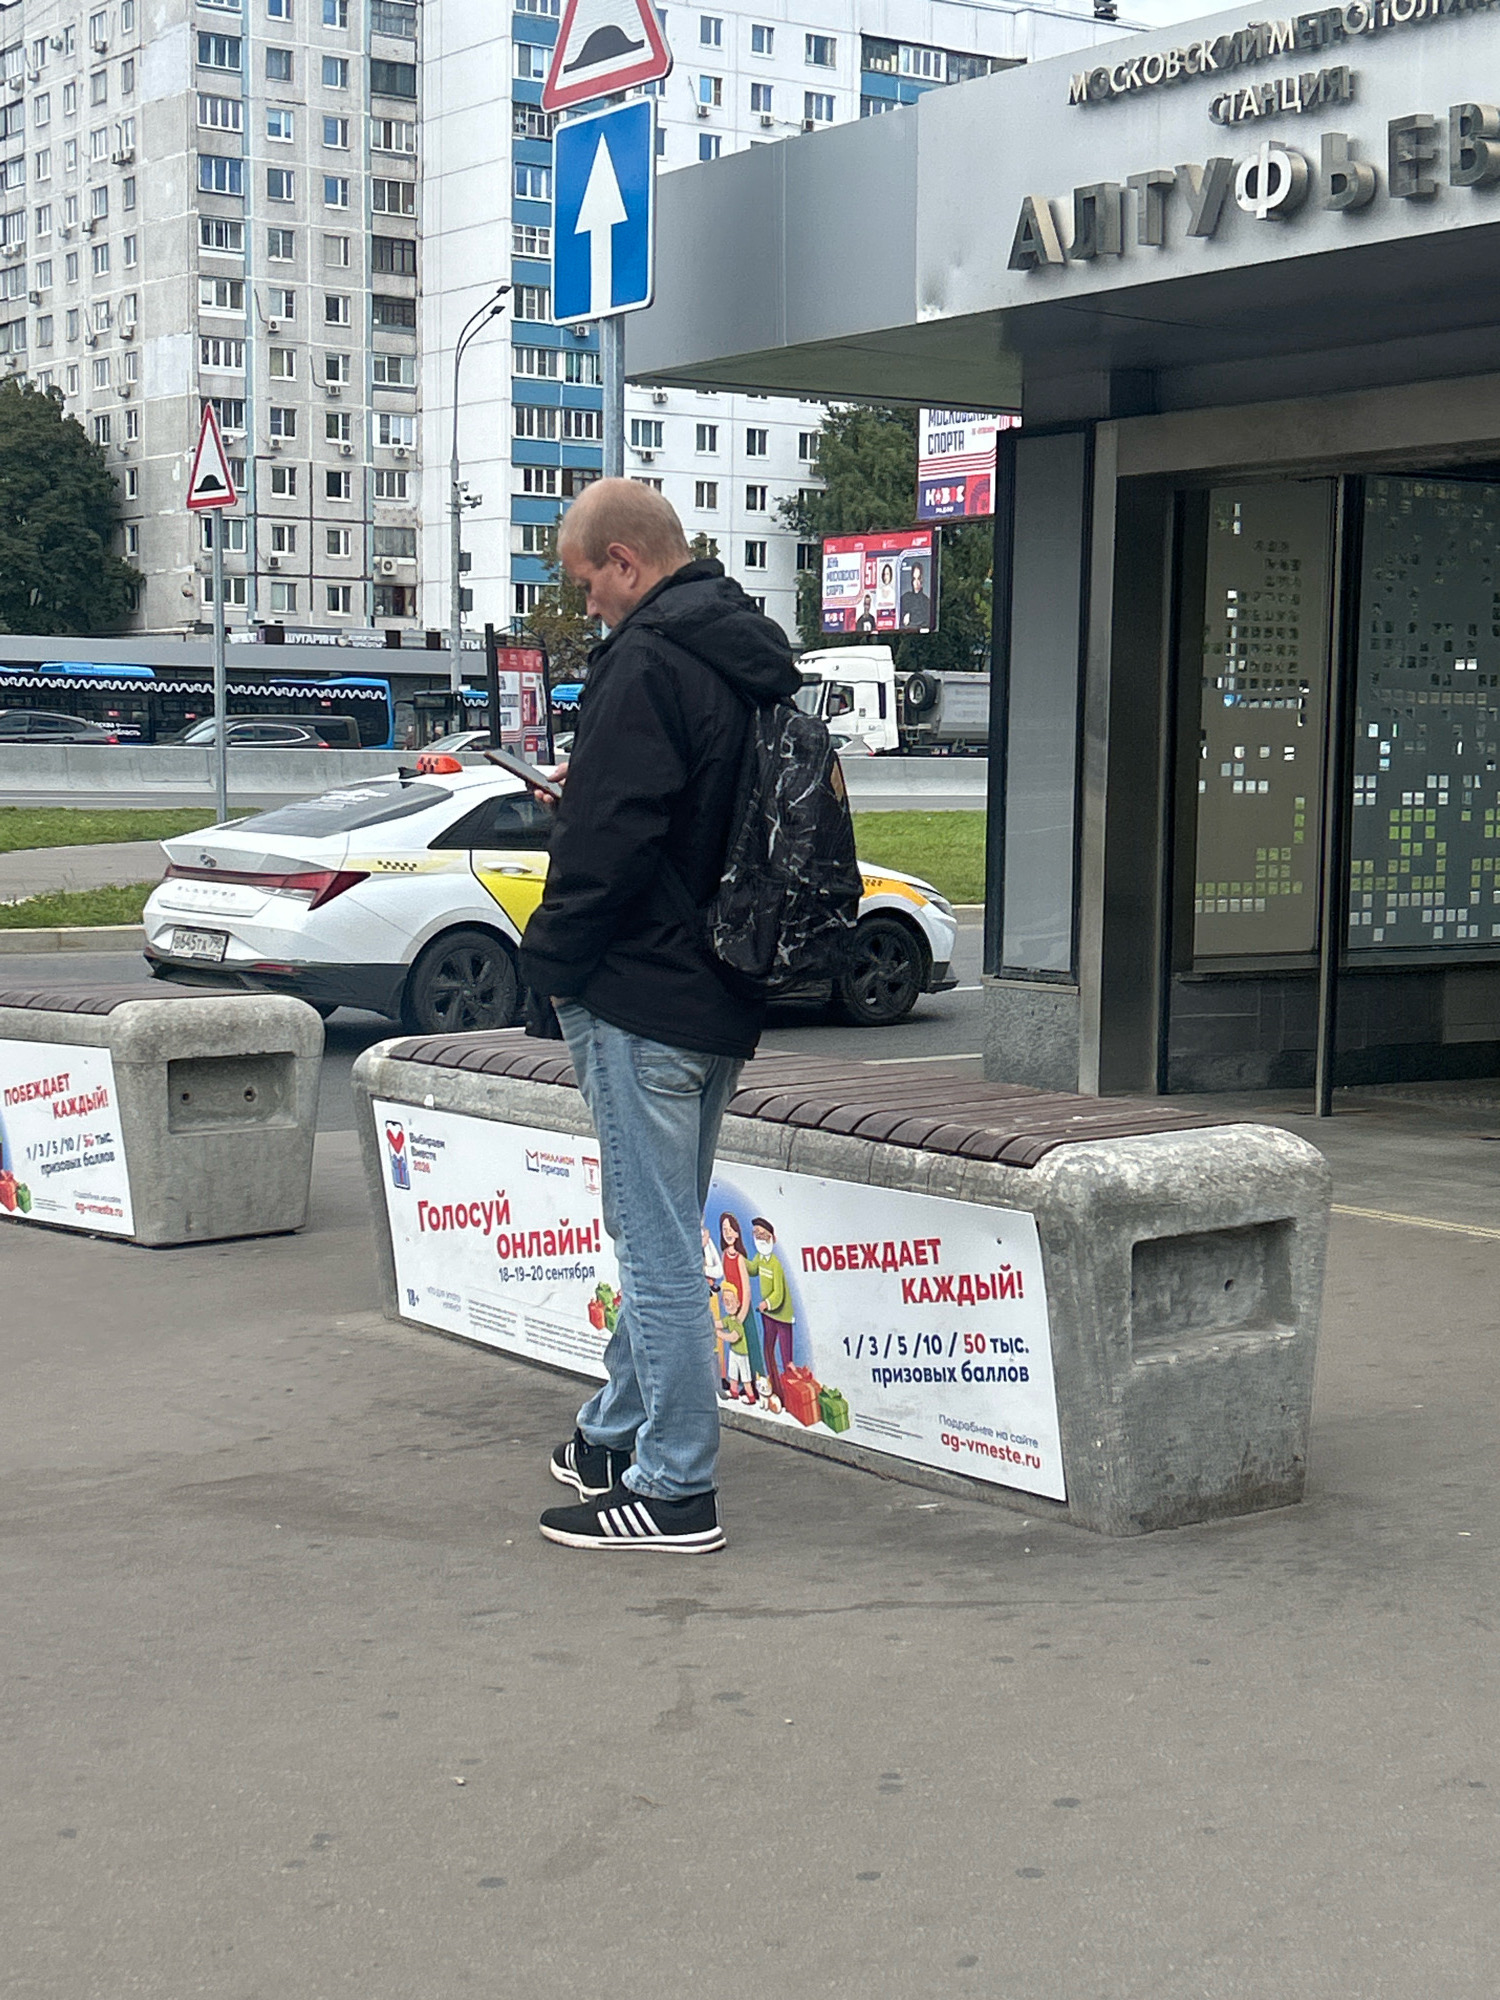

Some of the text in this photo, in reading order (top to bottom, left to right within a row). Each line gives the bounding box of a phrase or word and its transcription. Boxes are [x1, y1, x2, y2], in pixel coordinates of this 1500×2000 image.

[1067, 22, 1268, 105] МОСКОВСКИЙ
[1208, 65, 1354, 125] СТАНЦИЯ
[928, 430, 965, 455] СПОРТА
[284, 633, 339, 645] ШУГАРИНГ
[4, 1073, 70, 1107] ПОБЕЖДАЕТ
[52, 1084, 110, 1120] КАЖДЫЙ!
[417, 1189, 511, 1236] Голосуй
[496, 1218, 601, 1260] онлайн!
[801, 1238, 942, 1273] ПОБЕЖДАЕТ
[546, 1262, 596, 1282] сентября
[902, 1263, 1024, 1306] КАЖДЫЙ!
[990, 1337, 1030, 1355] тыс.
[872, 1360, 1030, 1389] призовых баллов
[939, 1413, 993, 1437] Подробнее
[996, 1430, 1008, 1441] на
[1010, 1433, 1039, 1449] сайте
[941, 1433, 1041, 1469] ag-vmeste.ru
